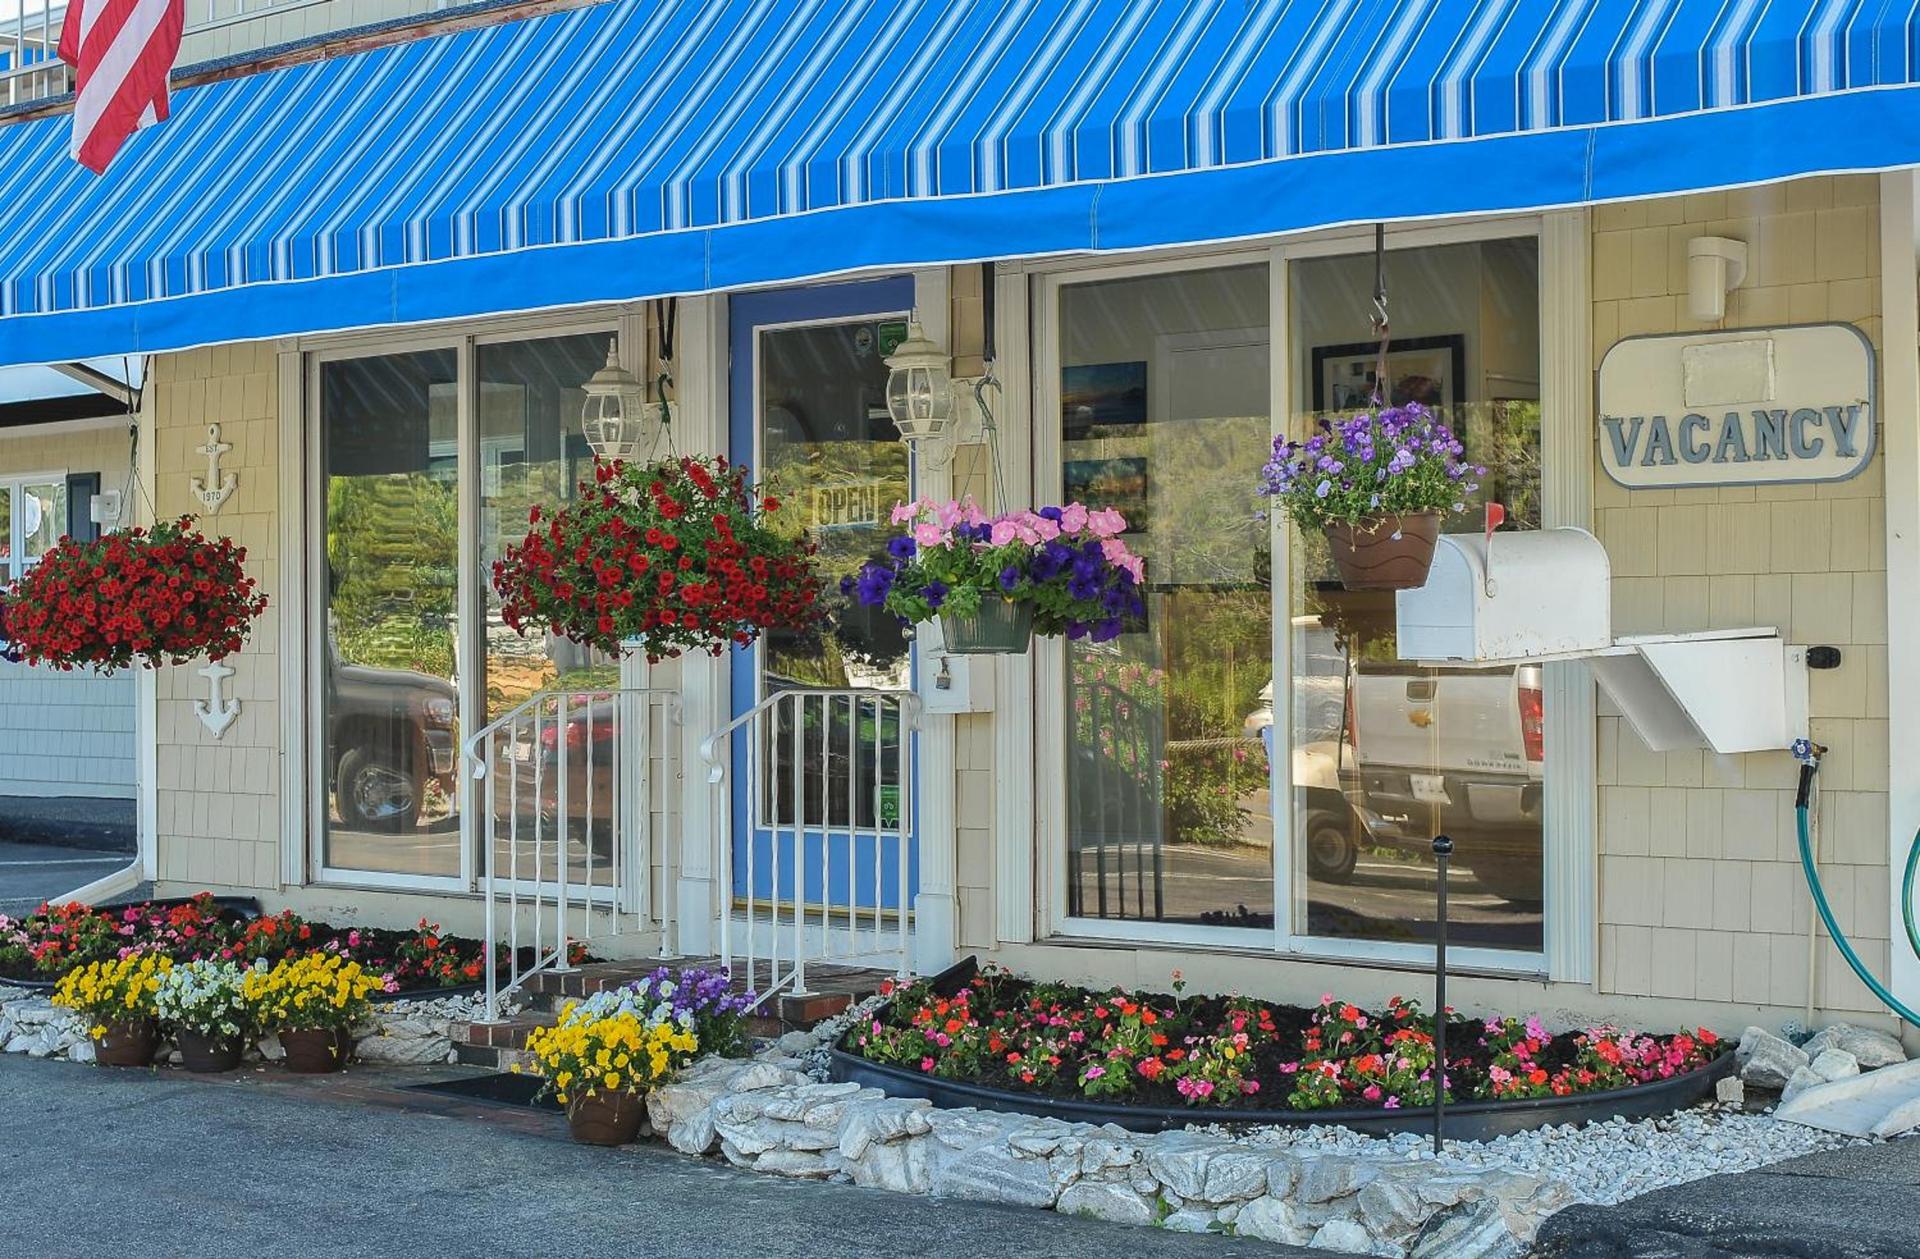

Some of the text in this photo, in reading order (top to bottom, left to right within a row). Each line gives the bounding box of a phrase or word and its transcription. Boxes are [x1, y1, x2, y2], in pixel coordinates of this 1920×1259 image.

[1602, 404, 1863, 467] VACANCY
[202, 491, 221, 502] 1970
[818, 485, 875, 526] OPEN
